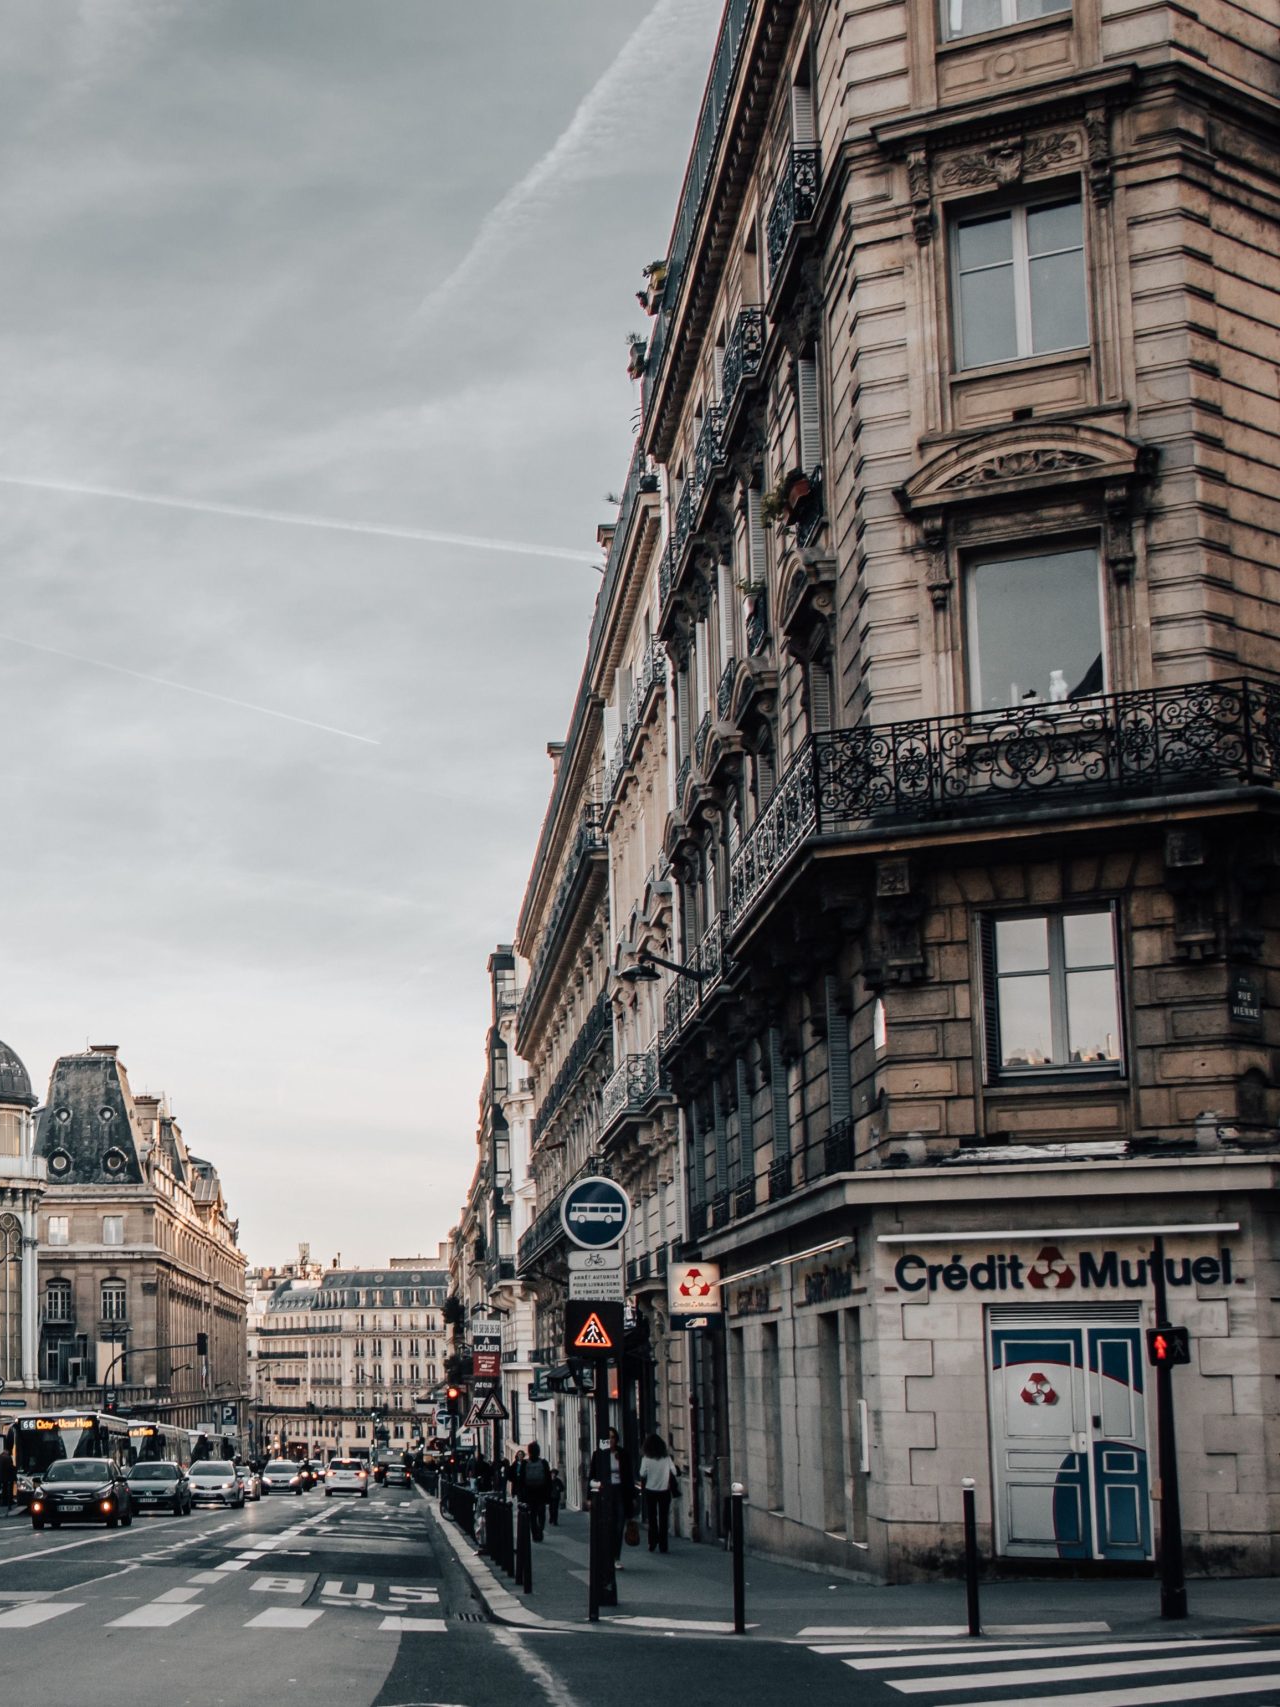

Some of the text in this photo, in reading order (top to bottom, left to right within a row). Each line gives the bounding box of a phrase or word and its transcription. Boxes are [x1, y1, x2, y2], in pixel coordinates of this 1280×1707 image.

[1238, 991, 1252, 1001] RUE
[1232, 1005, 1260, 1018] VIENNE
[894, 1254, 1024, 1292] Crédit
[1078, 1247, 1232, 1288] Mutuel
[473, 1344, 500, 1352] LOUER
[23, 1420, 34, 1429] 66
[248, 1576, 440, 1604] BUS
